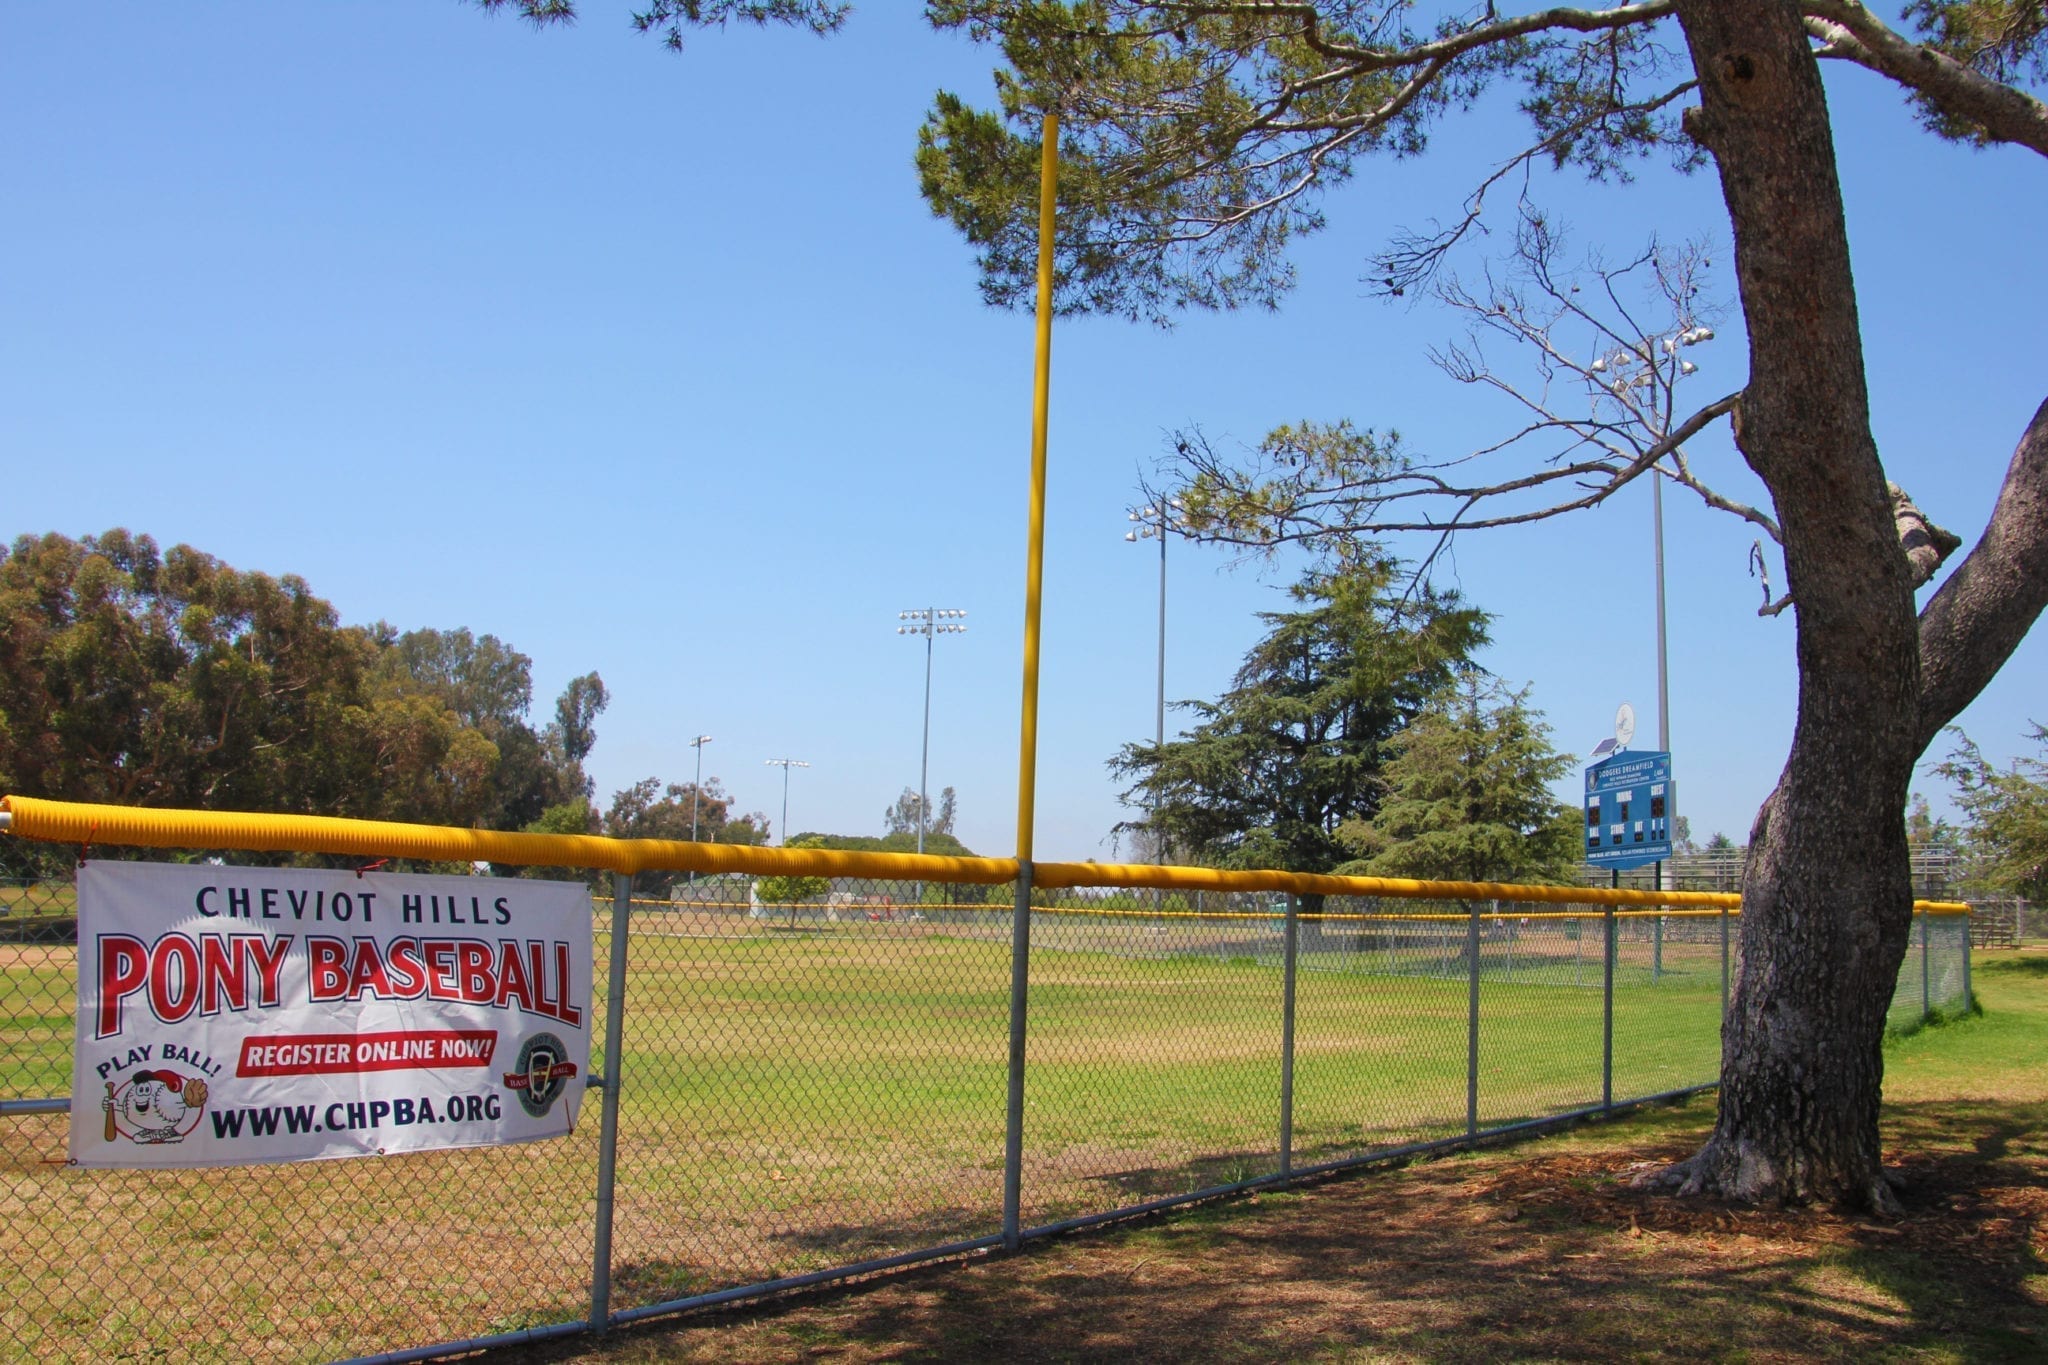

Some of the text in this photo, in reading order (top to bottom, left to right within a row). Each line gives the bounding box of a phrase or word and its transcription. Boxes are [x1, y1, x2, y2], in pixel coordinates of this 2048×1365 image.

[1598, 767, 1621, 778] DODGERS
[1622, 761, 1654, 774] DREAMFIELD
[1651, 783, 1664, 796] GUEST
[196, 886, 511, 925] CHEVIOT HILLS
[96, 932, 581, 1040] PONY BASEBALL
[96, 1043, 222, 1080] PLAY BALL!
[246, 1038, 493, 1067] REGISTER ONLINE NOW!
[509, 1067, 569, 1087] BASE BALL
[211, 1094, 501, 1139] WWW.CHPBA.ORG
